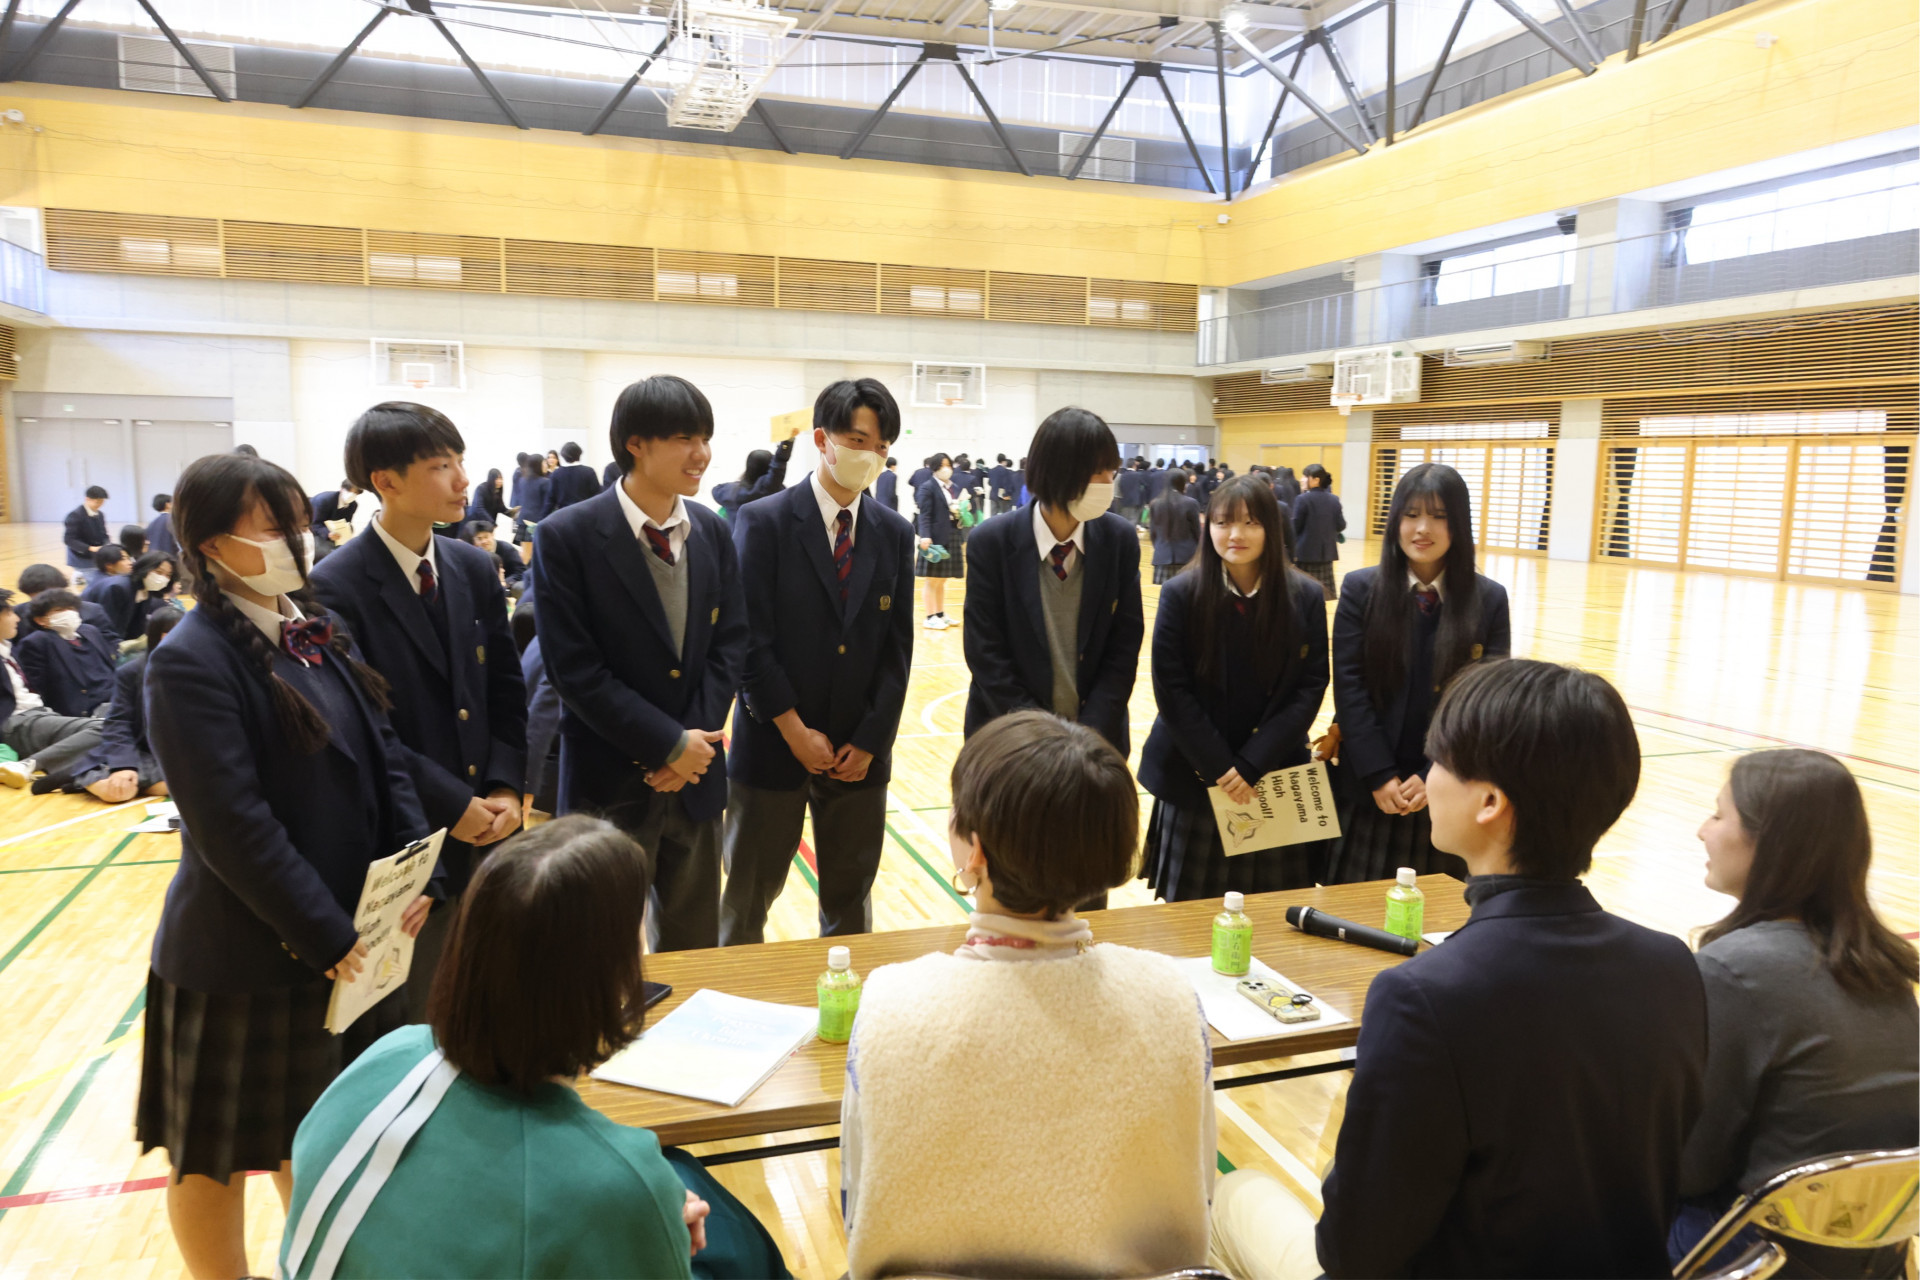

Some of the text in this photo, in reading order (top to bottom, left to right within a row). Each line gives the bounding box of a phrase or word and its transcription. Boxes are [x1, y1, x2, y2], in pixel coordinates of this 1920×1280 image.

[1271, 775, 1286, 798] High
[1289, 771, 1308, 823] Nagayama
[1306, 767, 1329, 827] Welcome to
